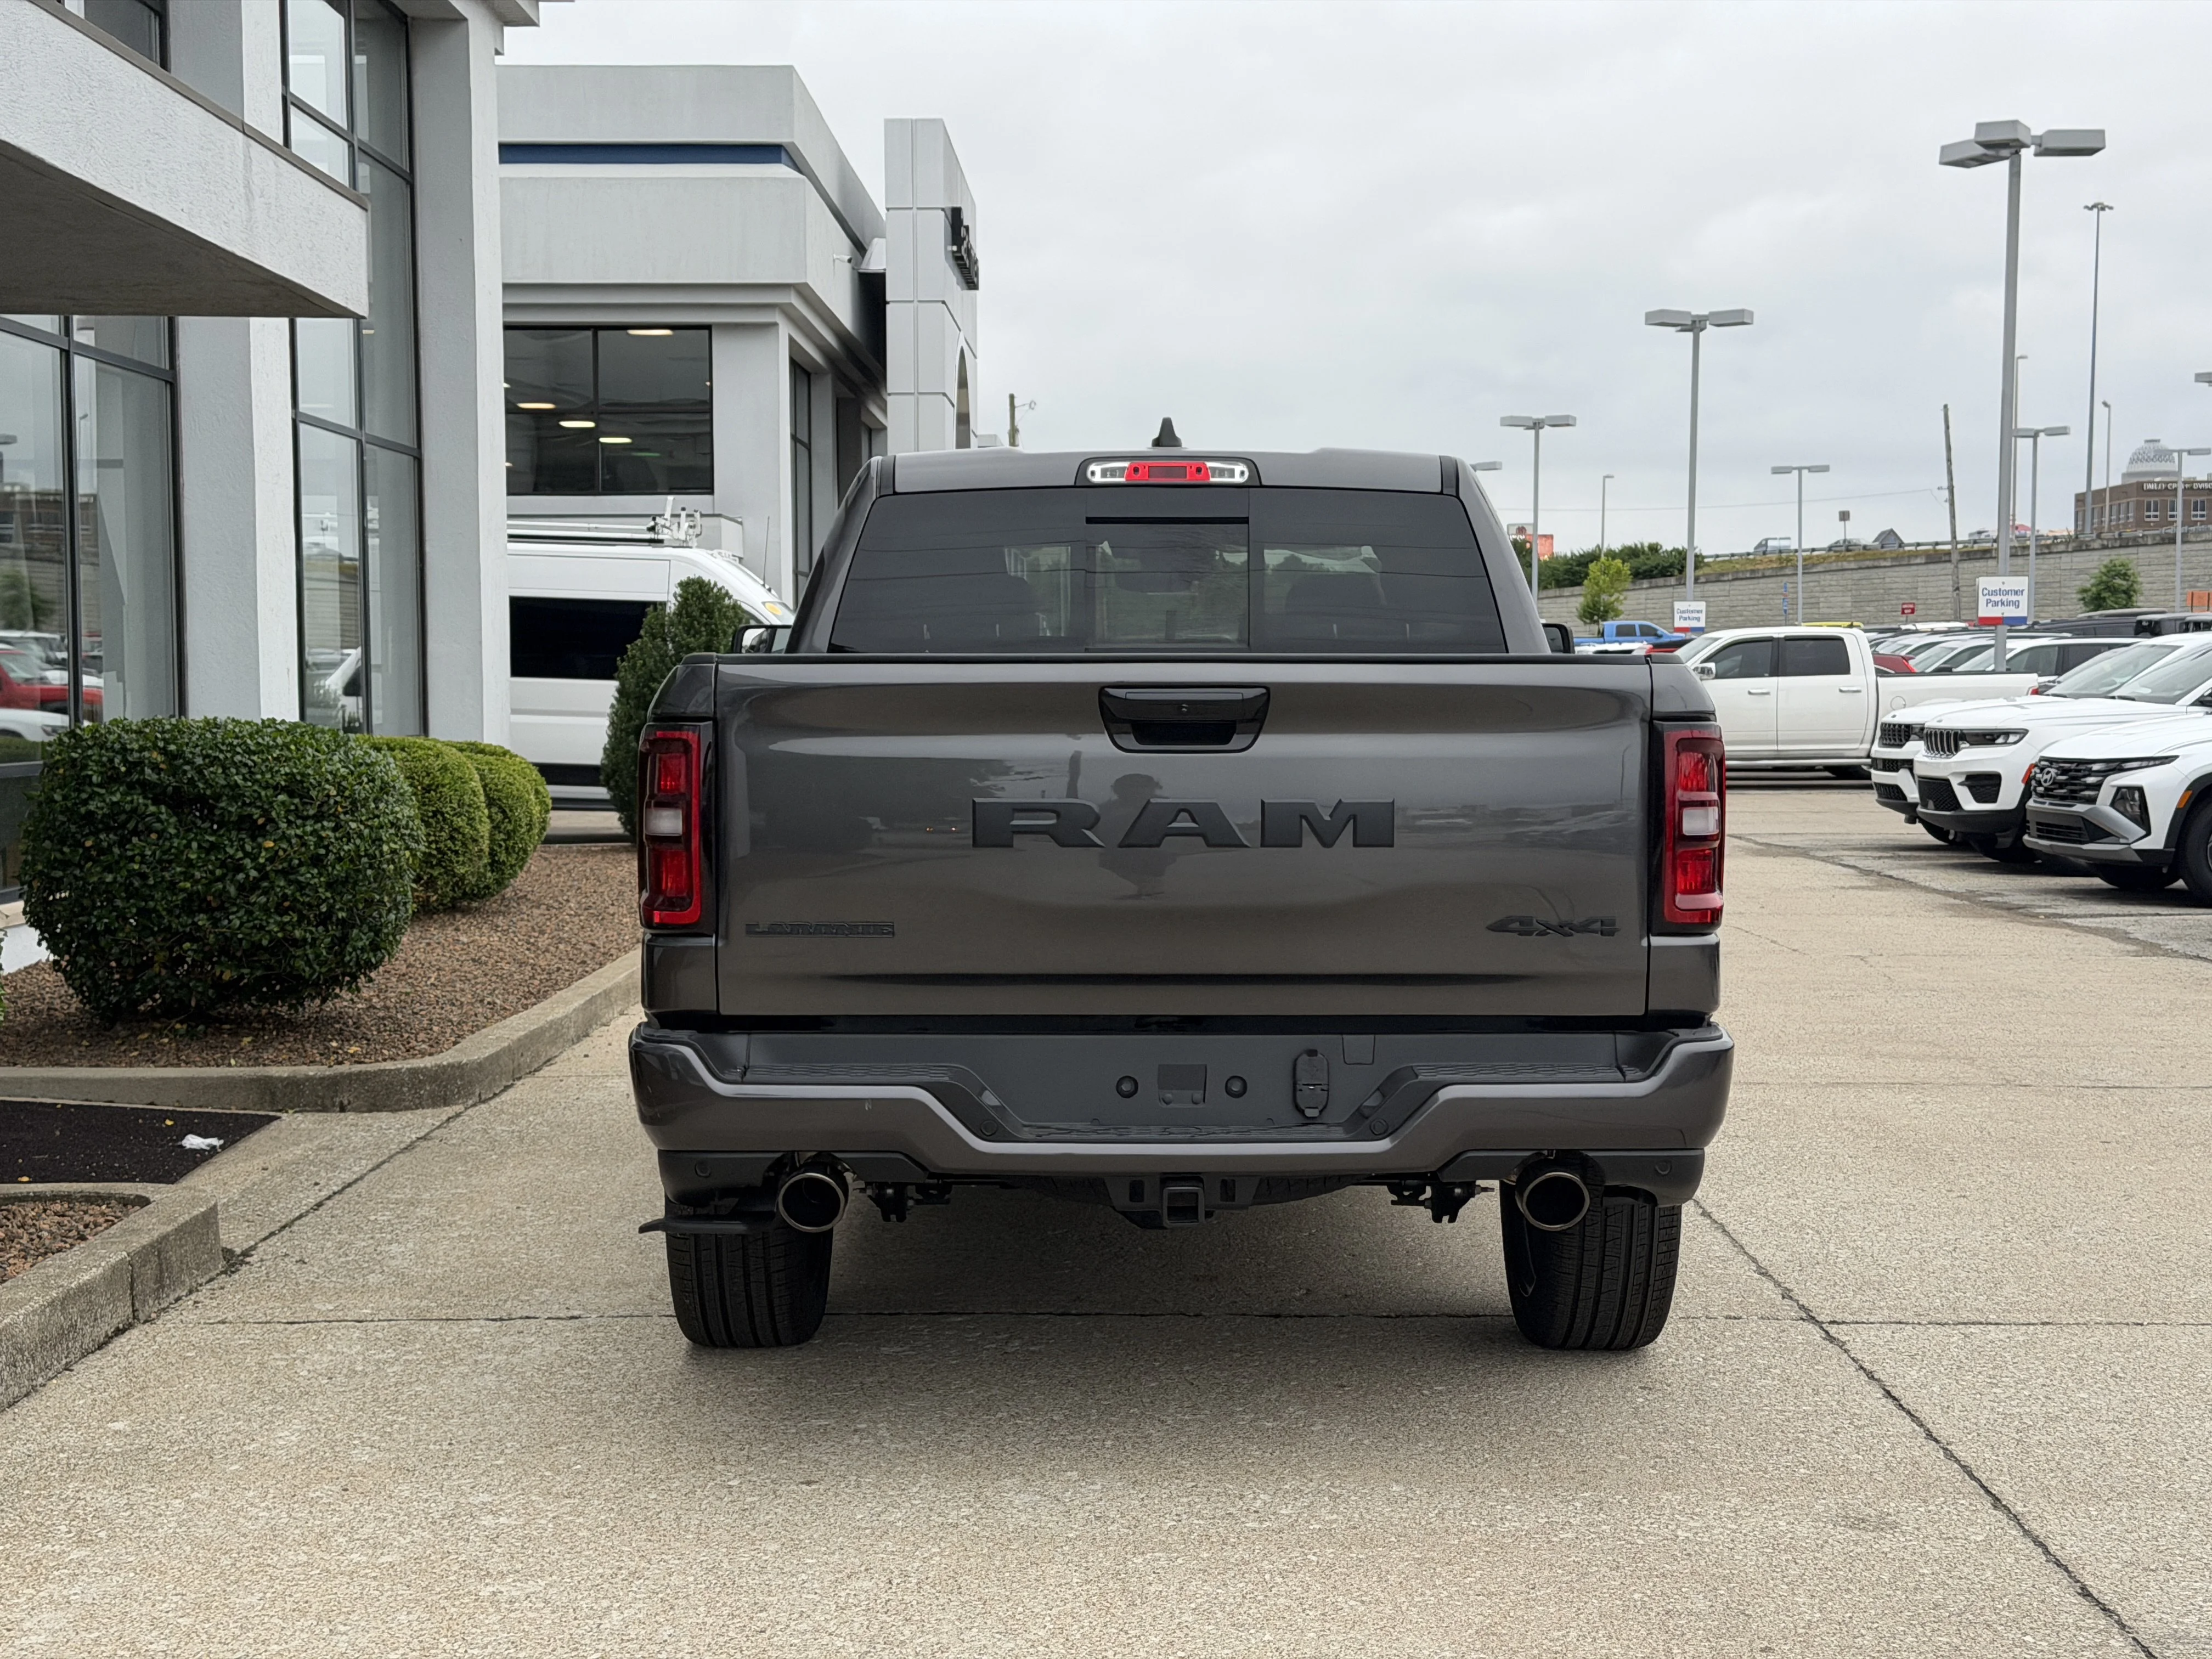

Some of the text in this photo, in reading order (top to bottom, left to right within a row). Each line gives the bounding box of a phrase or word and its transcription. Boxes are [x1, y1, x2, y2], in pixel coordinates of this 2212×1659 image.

[1982, 587, 2025, 597] Customer
[1985, 598, 2020, 609] Parking
[972, 797, 1395, 849] RAM
